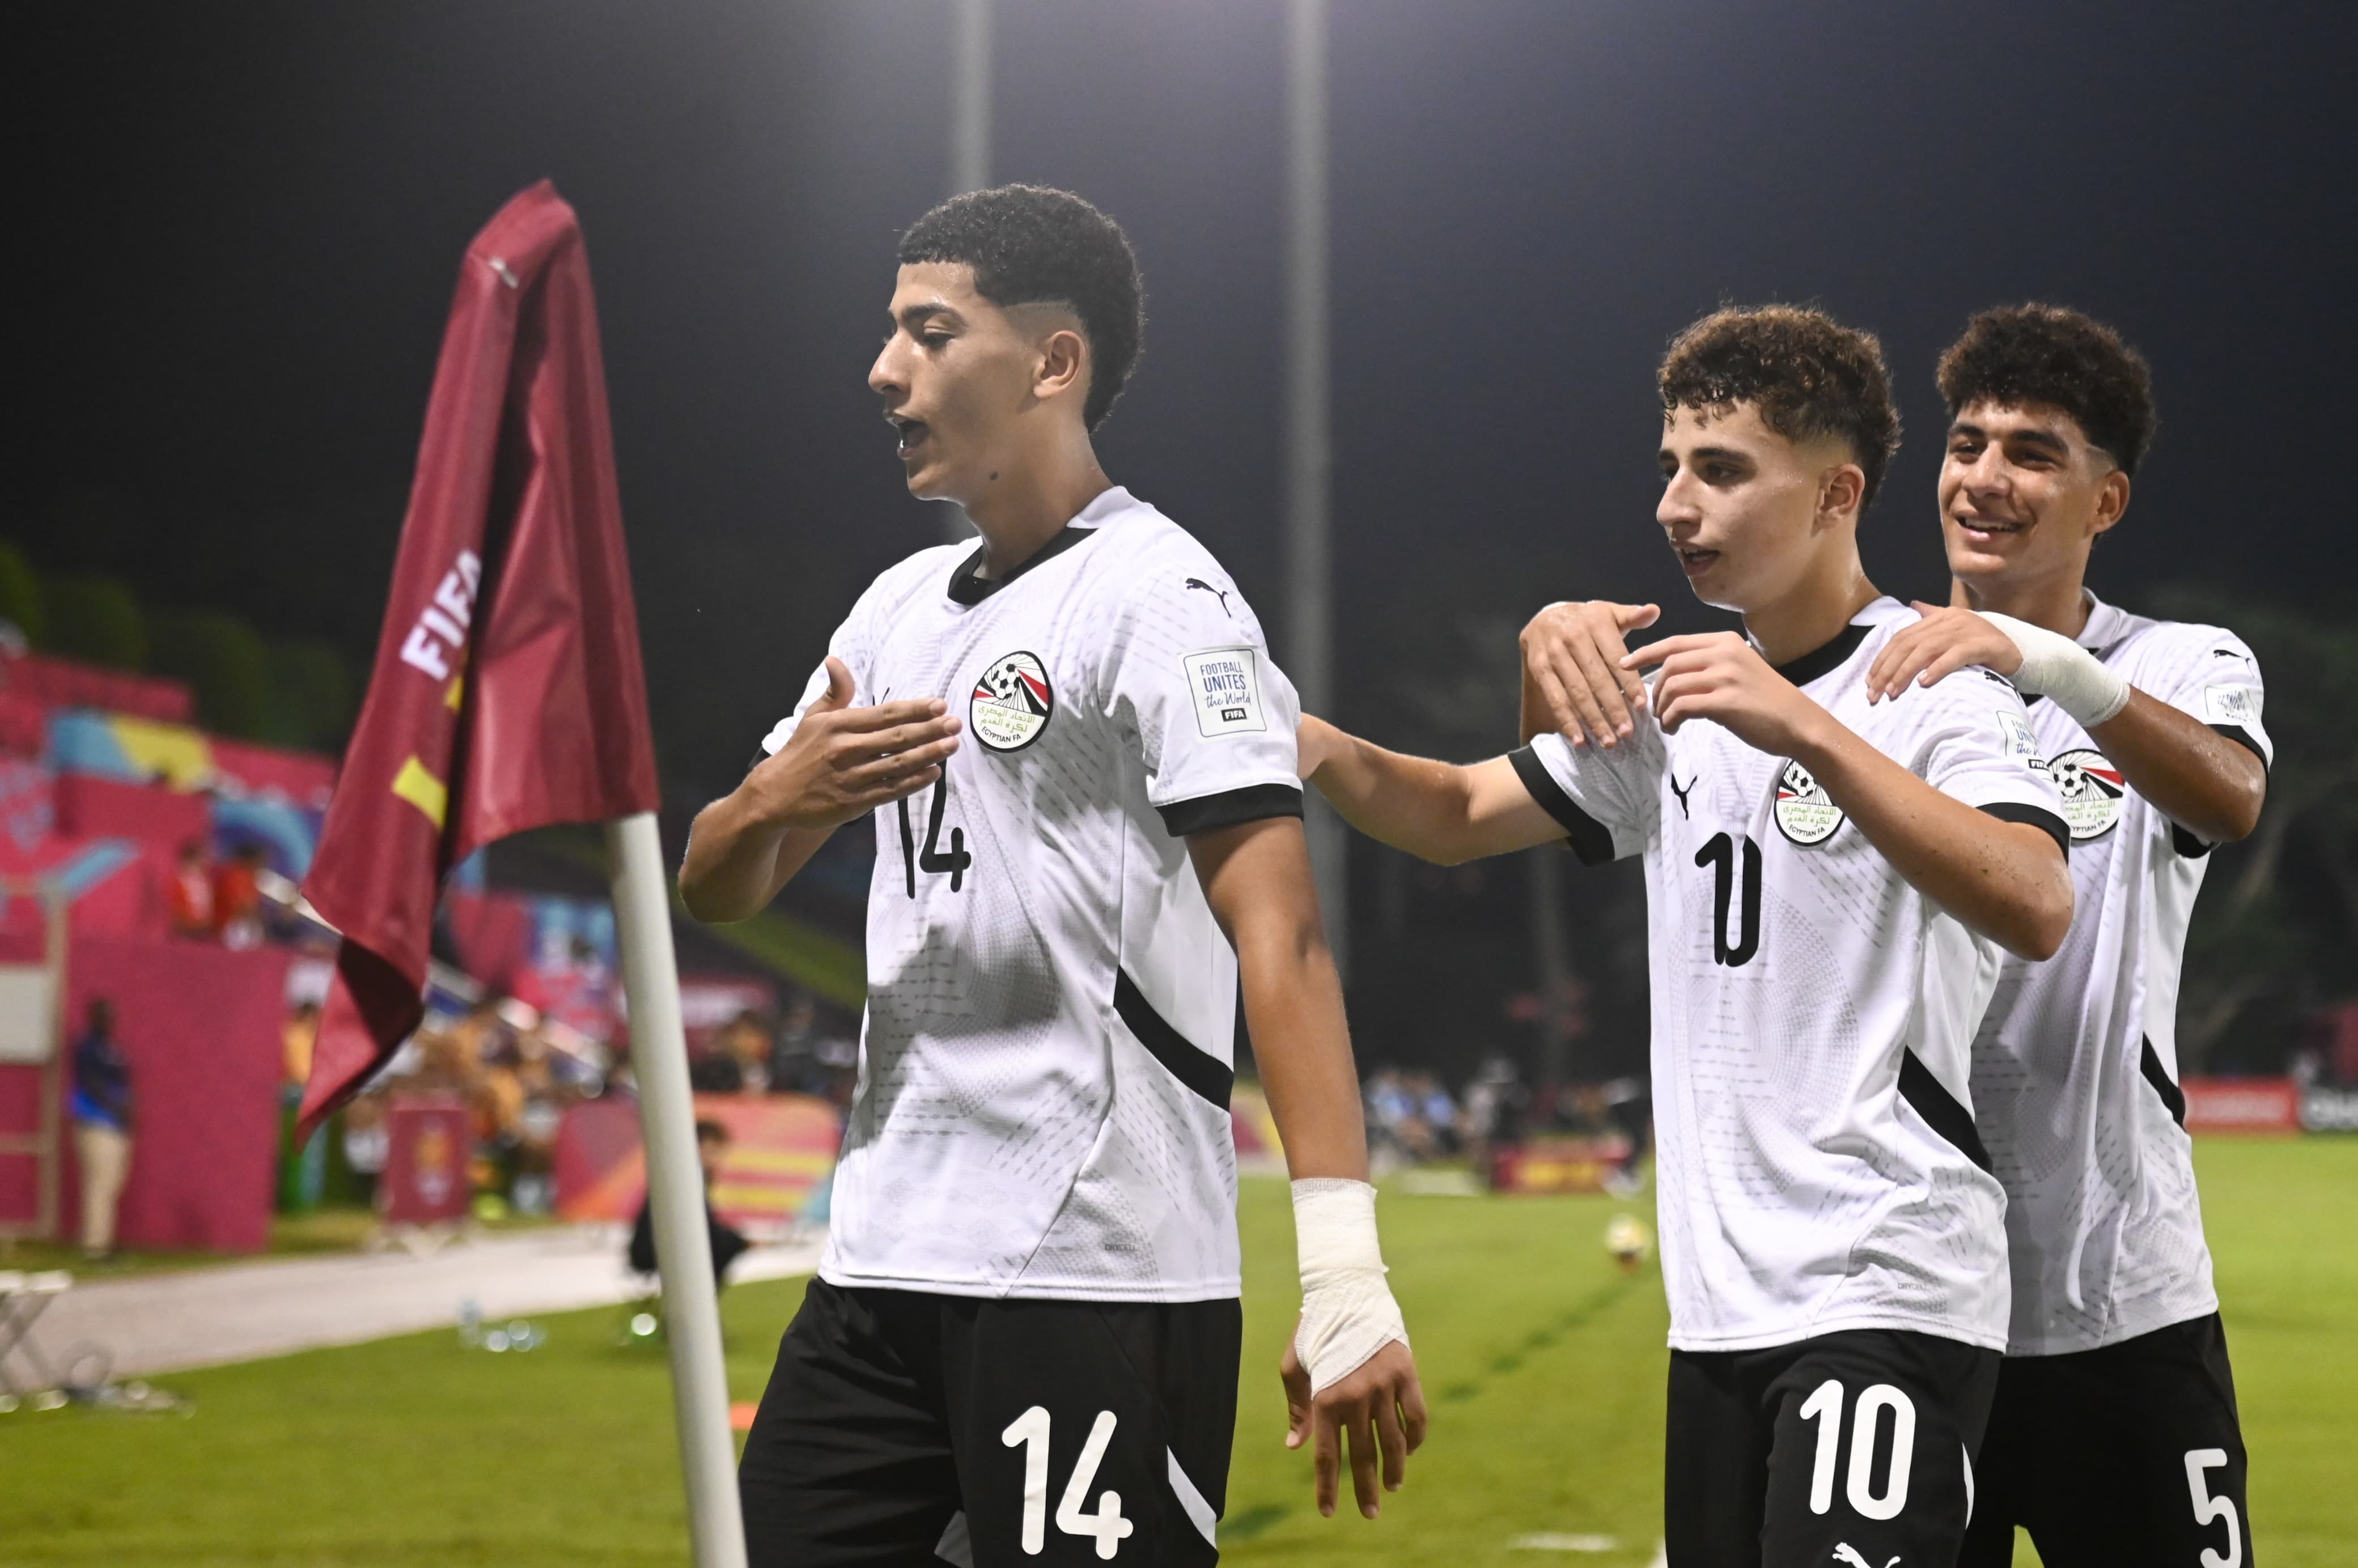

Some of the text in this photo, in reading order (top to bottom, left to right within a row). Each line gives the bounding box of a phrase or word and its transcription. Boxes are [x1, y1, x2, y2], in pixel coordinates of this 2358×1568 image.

[1200, 661, 1244, 676] FOOTBALL
[1203, 674, 1246, 692] UNITES
[1204, 690, 1252, 708] the World
[1225, 710, 1245, 720] FIFA
[982, 726, 1021, 742] EGYPTIAN FA
[2016, 742, 2032, 754] the
[897, 757, 972, 899] 14
[1789, 824, 1825, 837] EGYPTIAN FA
[1695, 832, 1762, 967] 10
[1800, 1379, 1916, 1520] 10
[1002, 1405, 1134, 1560] 14
[2184, 1448, 2242, 1568] 5
